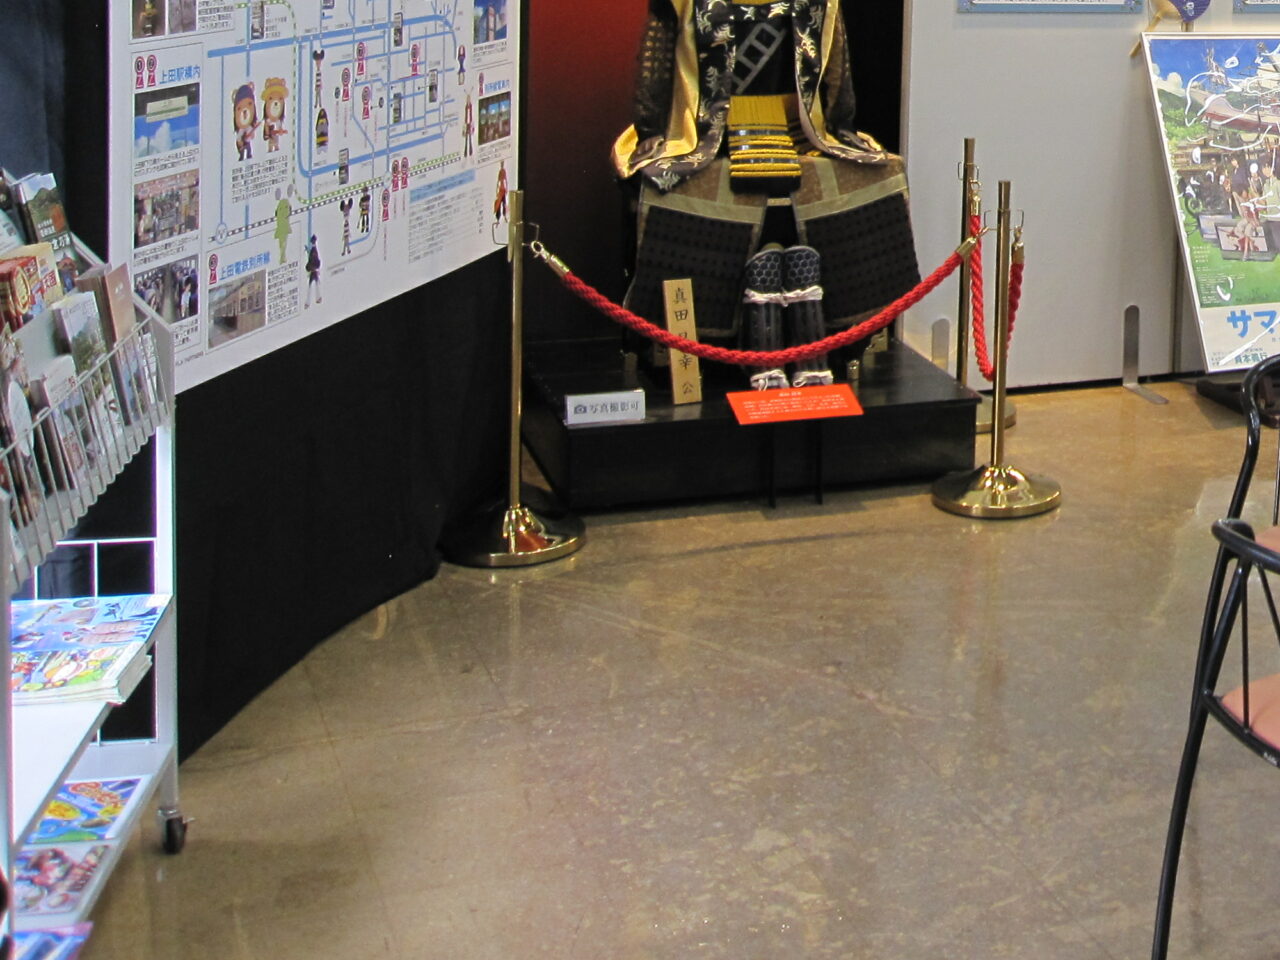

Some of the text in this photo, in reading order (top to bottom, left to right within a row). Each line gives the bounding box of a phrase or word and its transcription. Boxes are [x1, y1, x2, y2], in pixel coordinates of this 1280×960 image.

[587, 400, 640, 415] 写真撮影可
